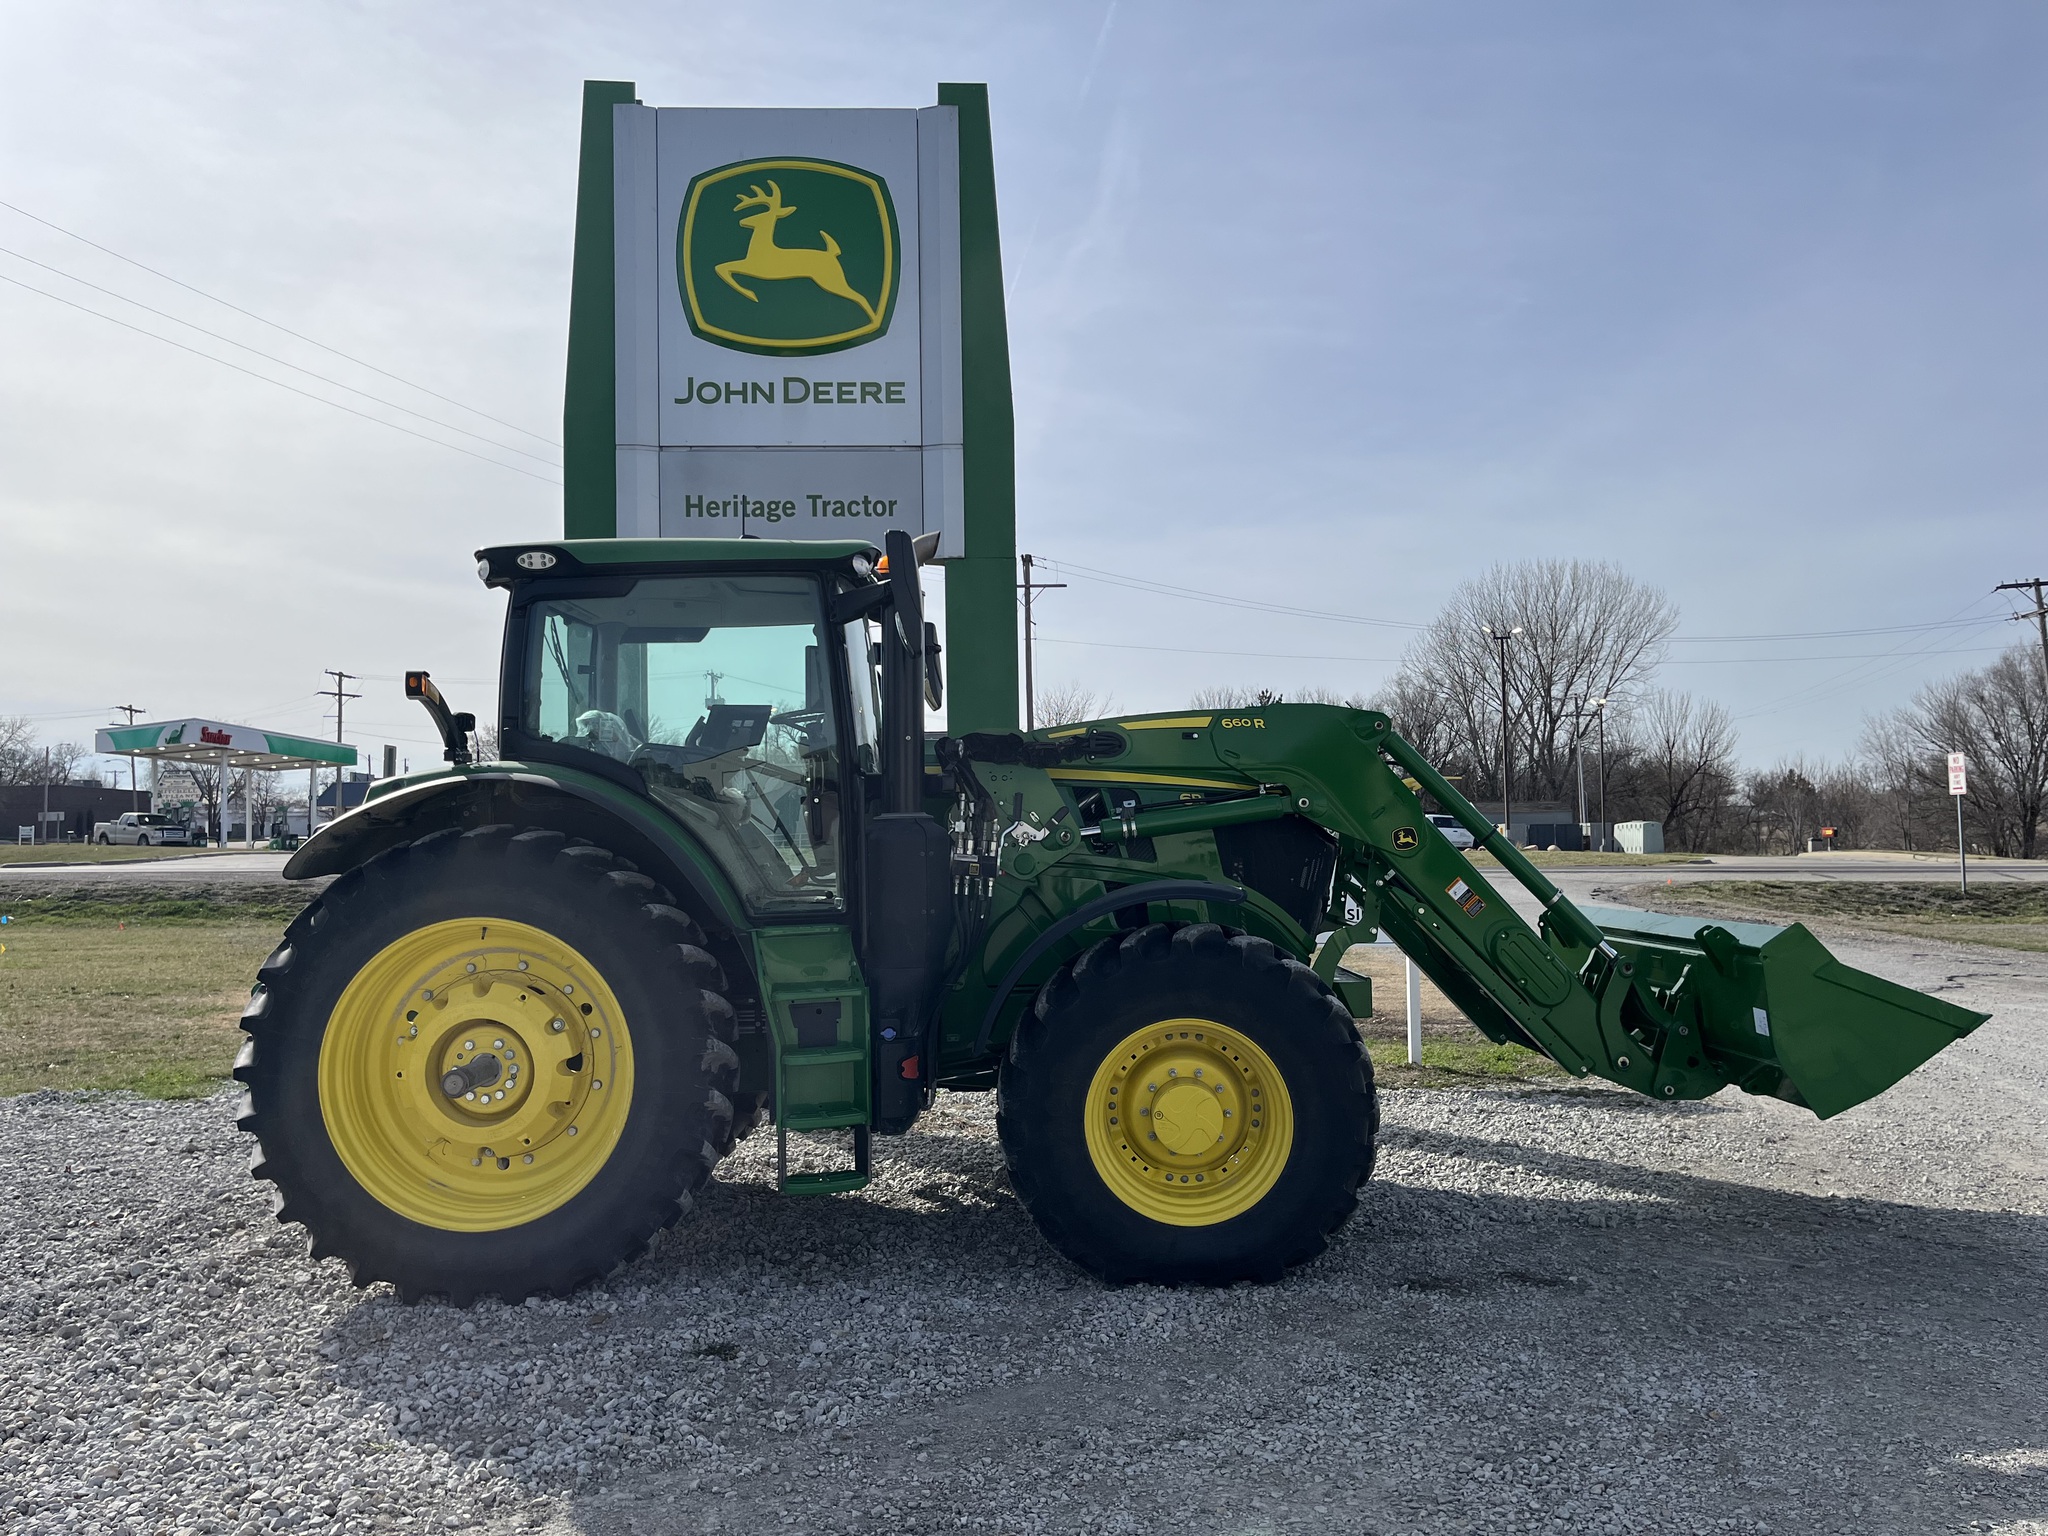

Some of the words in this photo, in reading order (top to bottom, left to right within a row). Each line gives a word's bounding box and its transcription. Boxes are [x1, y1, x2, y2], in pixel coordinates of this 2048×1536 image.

[674, 376, 774, 404] JOHN
[783, 376, 906, 404] DEERE
[685, 494, 796, 522] Heritage
[806, 494, 898, 517] Tractor
[1221, 718, 1251, 729] 660
[1253, 718, 1266, 729] R
